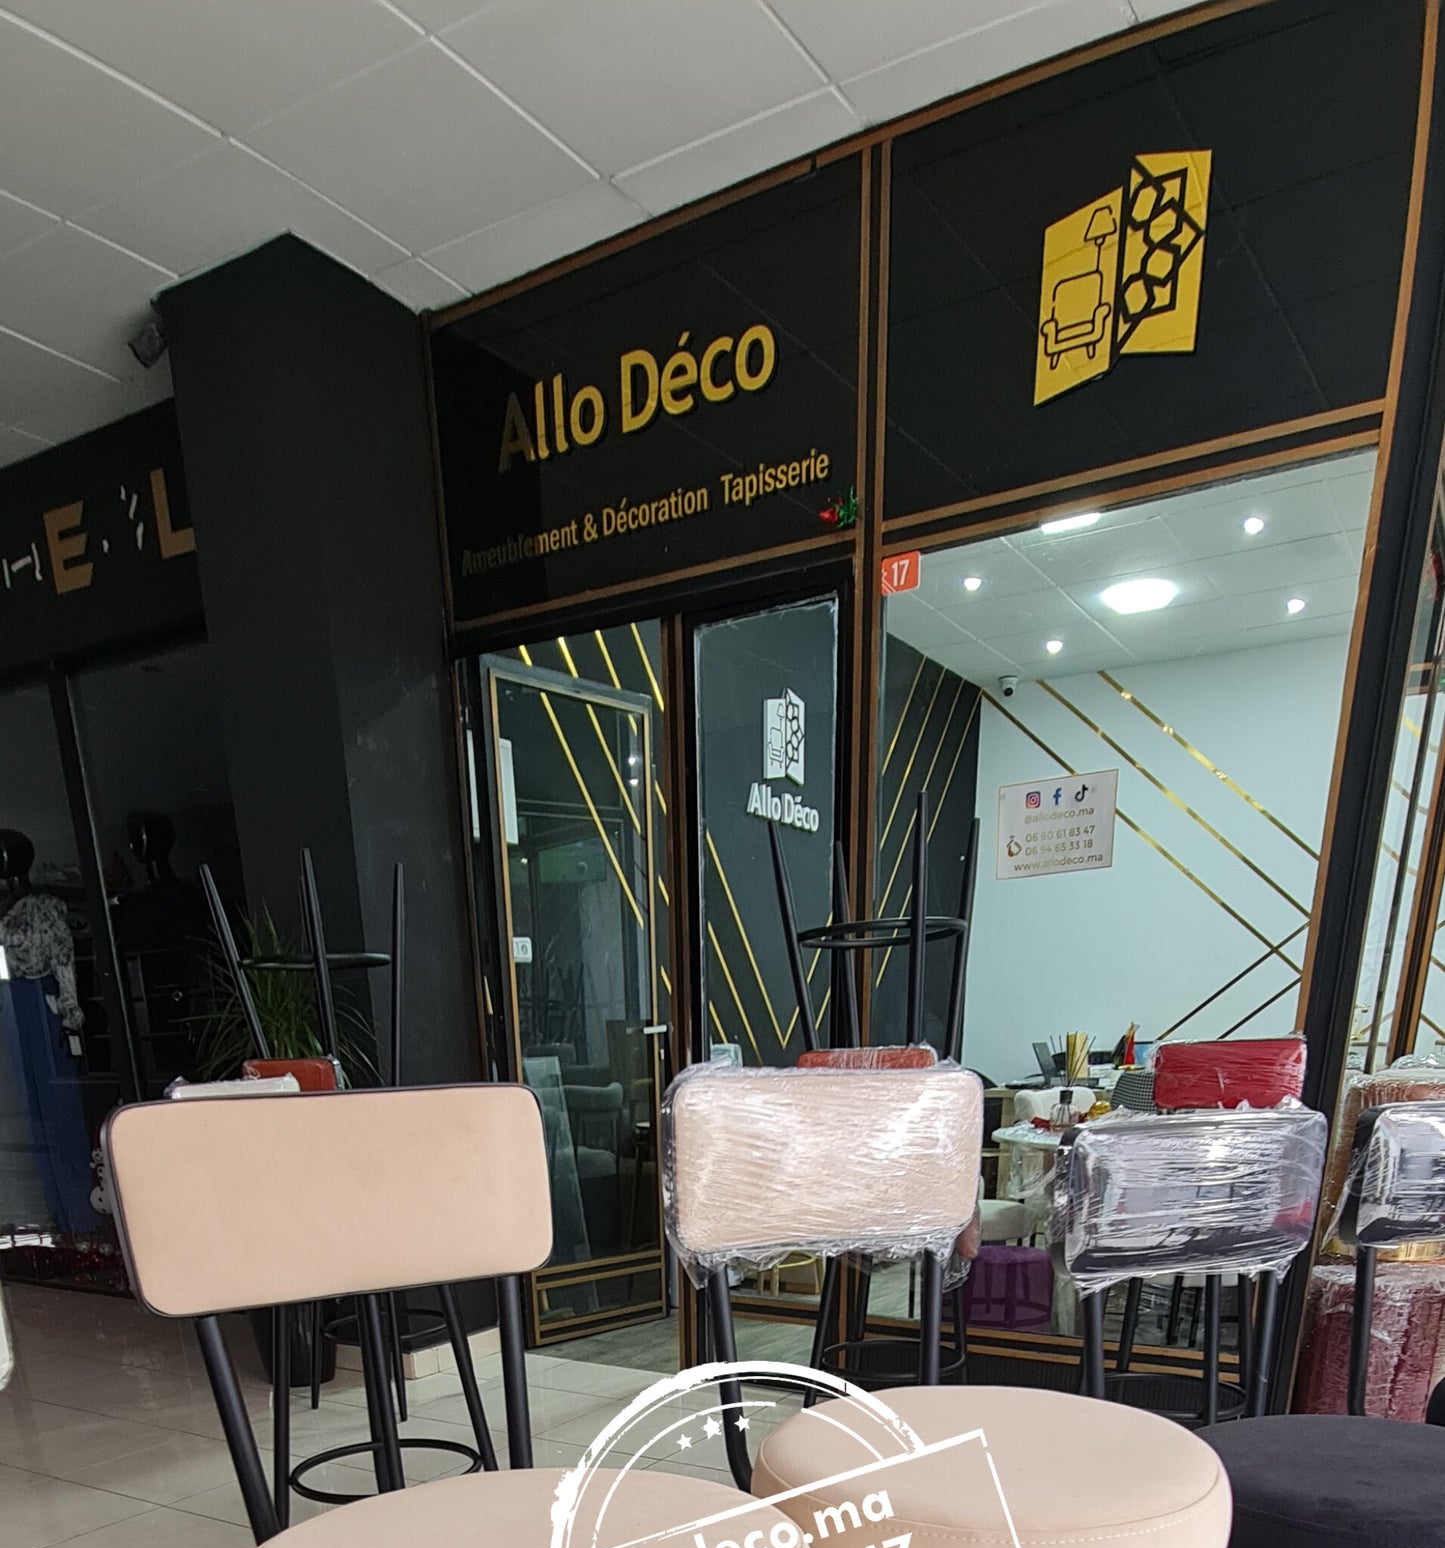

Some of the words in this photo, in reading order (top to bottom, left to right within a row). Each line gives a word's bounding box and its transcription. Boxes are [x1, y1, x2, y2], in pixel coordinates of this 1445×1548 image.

[498, 373, 605, 472] Allo
[620, 324, 776, 434] Déco
[461, 519, 579, 577] Ameublement
[583, 512, 599, 543] &
[602, 487, 708, 538] Décoration
[720, 448, 829, 509] Tapisserie
[891, 559, 910, 587] 17
[746, 782, 782, 821] Allo
[781, 793, 820, 832] Déco
[1025, 832, 1038, 843] 06
[1056, 828, 1067, 839] 61
[1068, 826, 1081, 837] 83
[1083, 825, 1095, 835] 47
[1025, 846, 1038, 856] 06
[1054, 843, 1066, 852] 65
[1068, 841, 1080, 851] 33
[1083, 839, 1094, 849] 18
[1013, 854, 1103, 871] www.allodeco.ma
